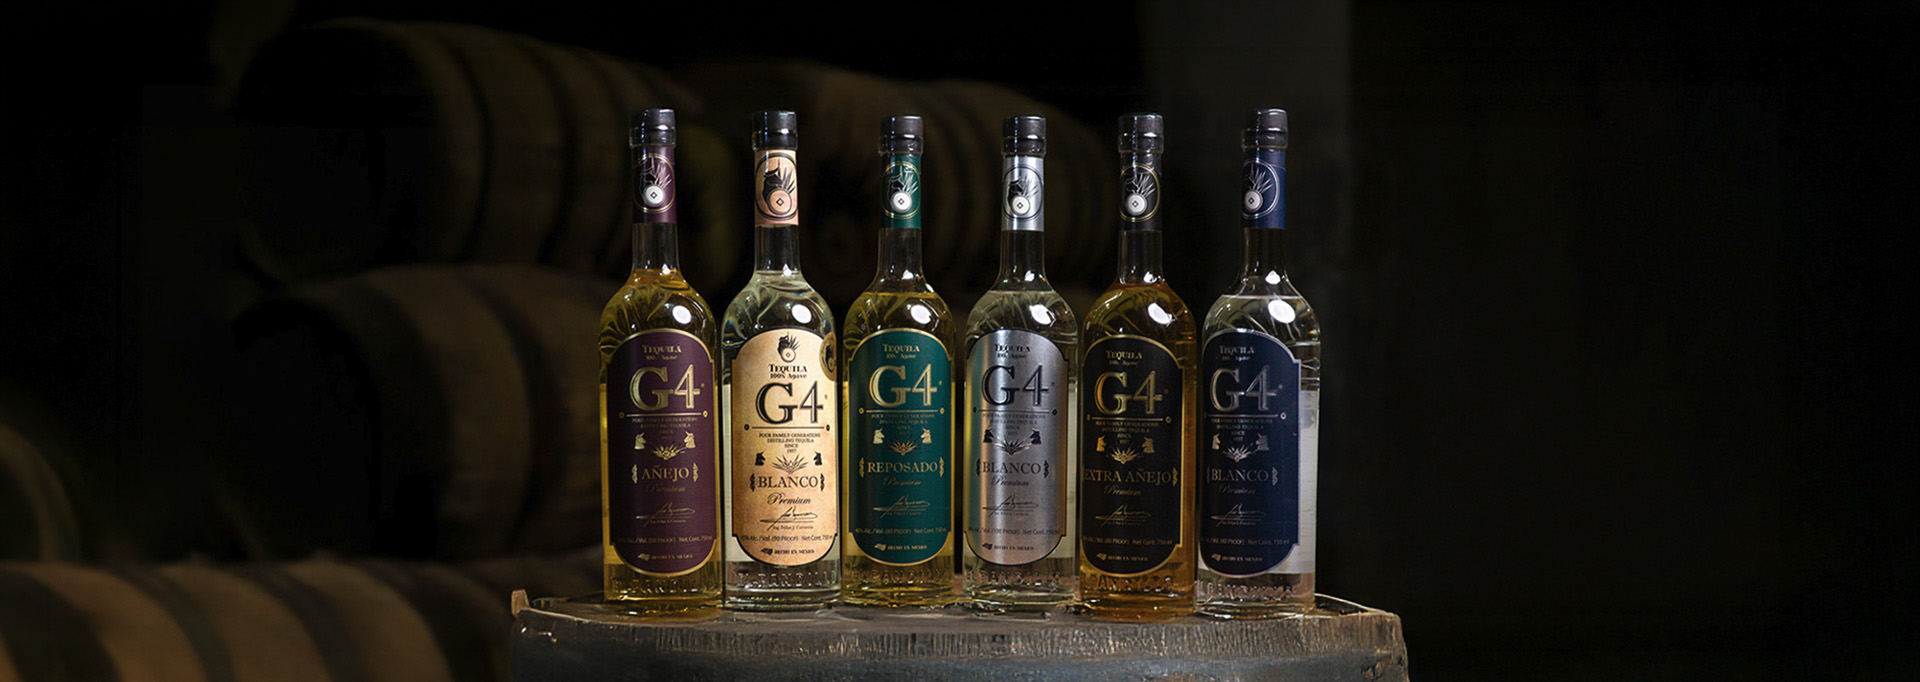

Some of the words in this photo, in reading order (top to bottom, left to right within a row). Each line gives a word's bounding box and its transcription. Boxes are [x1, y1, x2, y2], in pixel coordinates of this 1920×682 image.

[642, 345, 682, 355] TEQUILA
[882, 344, 921, 354] TEQUILA
[994, 343, 1031, 353] TEQUILA
[1220, 345, 1255, 355] TEQUILA
[1105, 350, 1143, 360] TEQUILA
[769, 364, 808, 374] TEQUILA
[629, 364, 701, 411] G4
[869, 363, 938, 408] G4
[982, 364, 1049, 406] G4
[1210, 365, 1277, 411] G4
[1094, 370, 1163, 415] G4
[755, 381, 824, 425] G4
[641, 465, 690, 482] AÑEJO
[867, 462, 939, 473] REPOSADO
[982, 462, 1042, 474] BLANCO
[1084, 469, 1122, 482] EXTRA
[1125, 468, 1172, 486] AÑEJO
[1211, 468, 1270, 481] BLANCO
[758, 476, 819, 488] BLANCO
[767, 492, 812, 505] Premium
